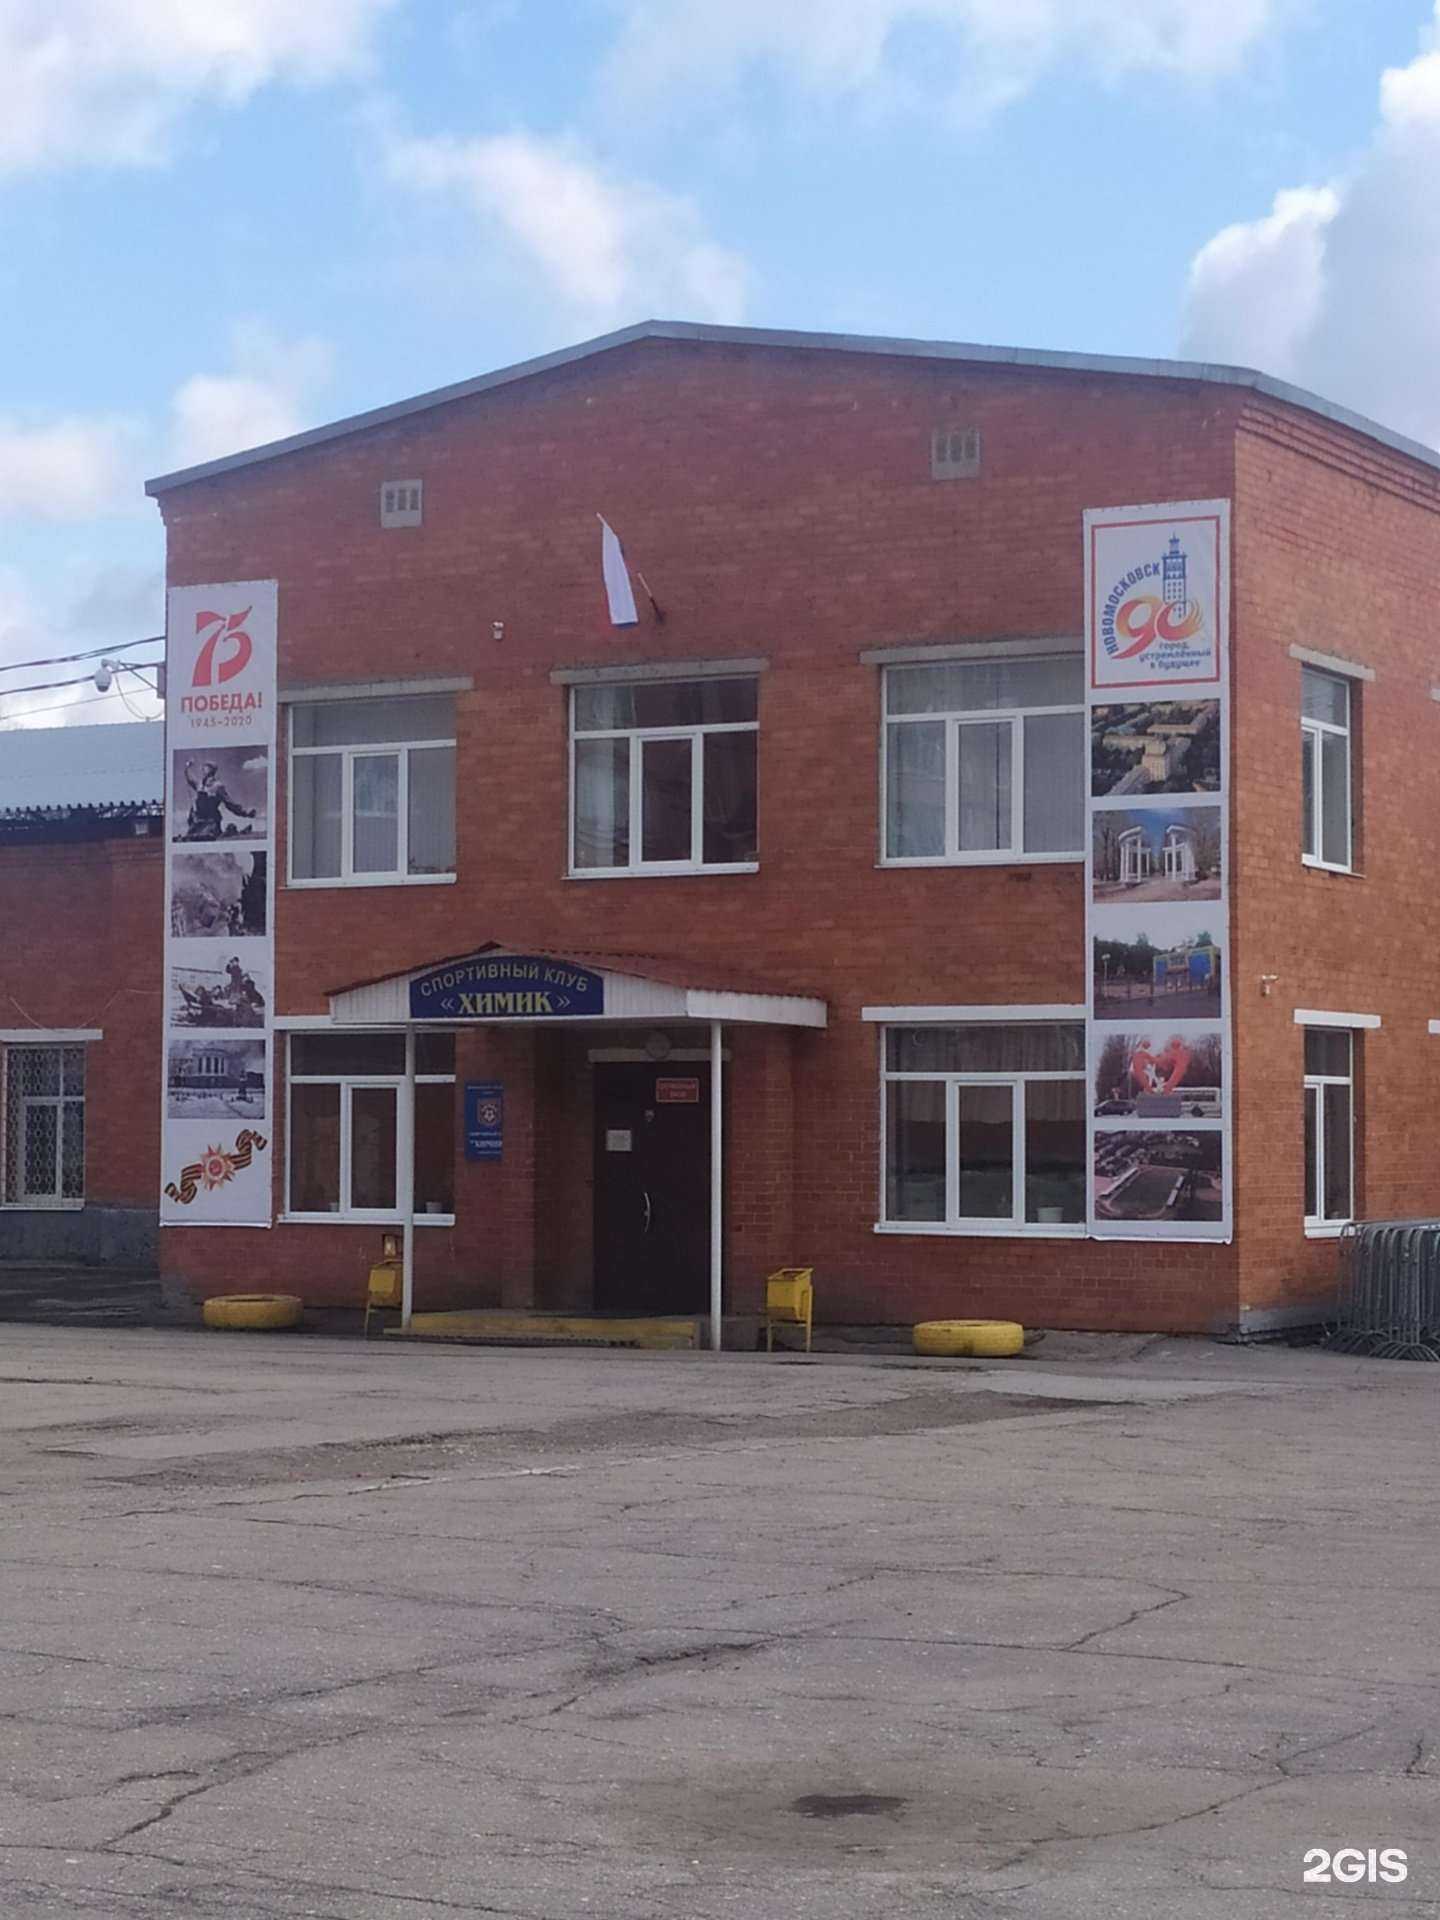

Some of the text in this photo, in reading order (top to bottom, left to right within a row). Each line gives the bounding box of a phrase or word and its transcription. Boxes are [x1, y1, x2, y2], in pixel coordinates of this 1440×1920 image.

[1102, 562, 1160, 656] НОВОМОСКОВСК
[1114, 595, 1204, 660] 90
[191, 605, 252, 688] 75
[181, 691, 262, 713] ПОБЕДА!
[420, 963, 589, 997] СПОРТИВНЫЙ КЛУБ
